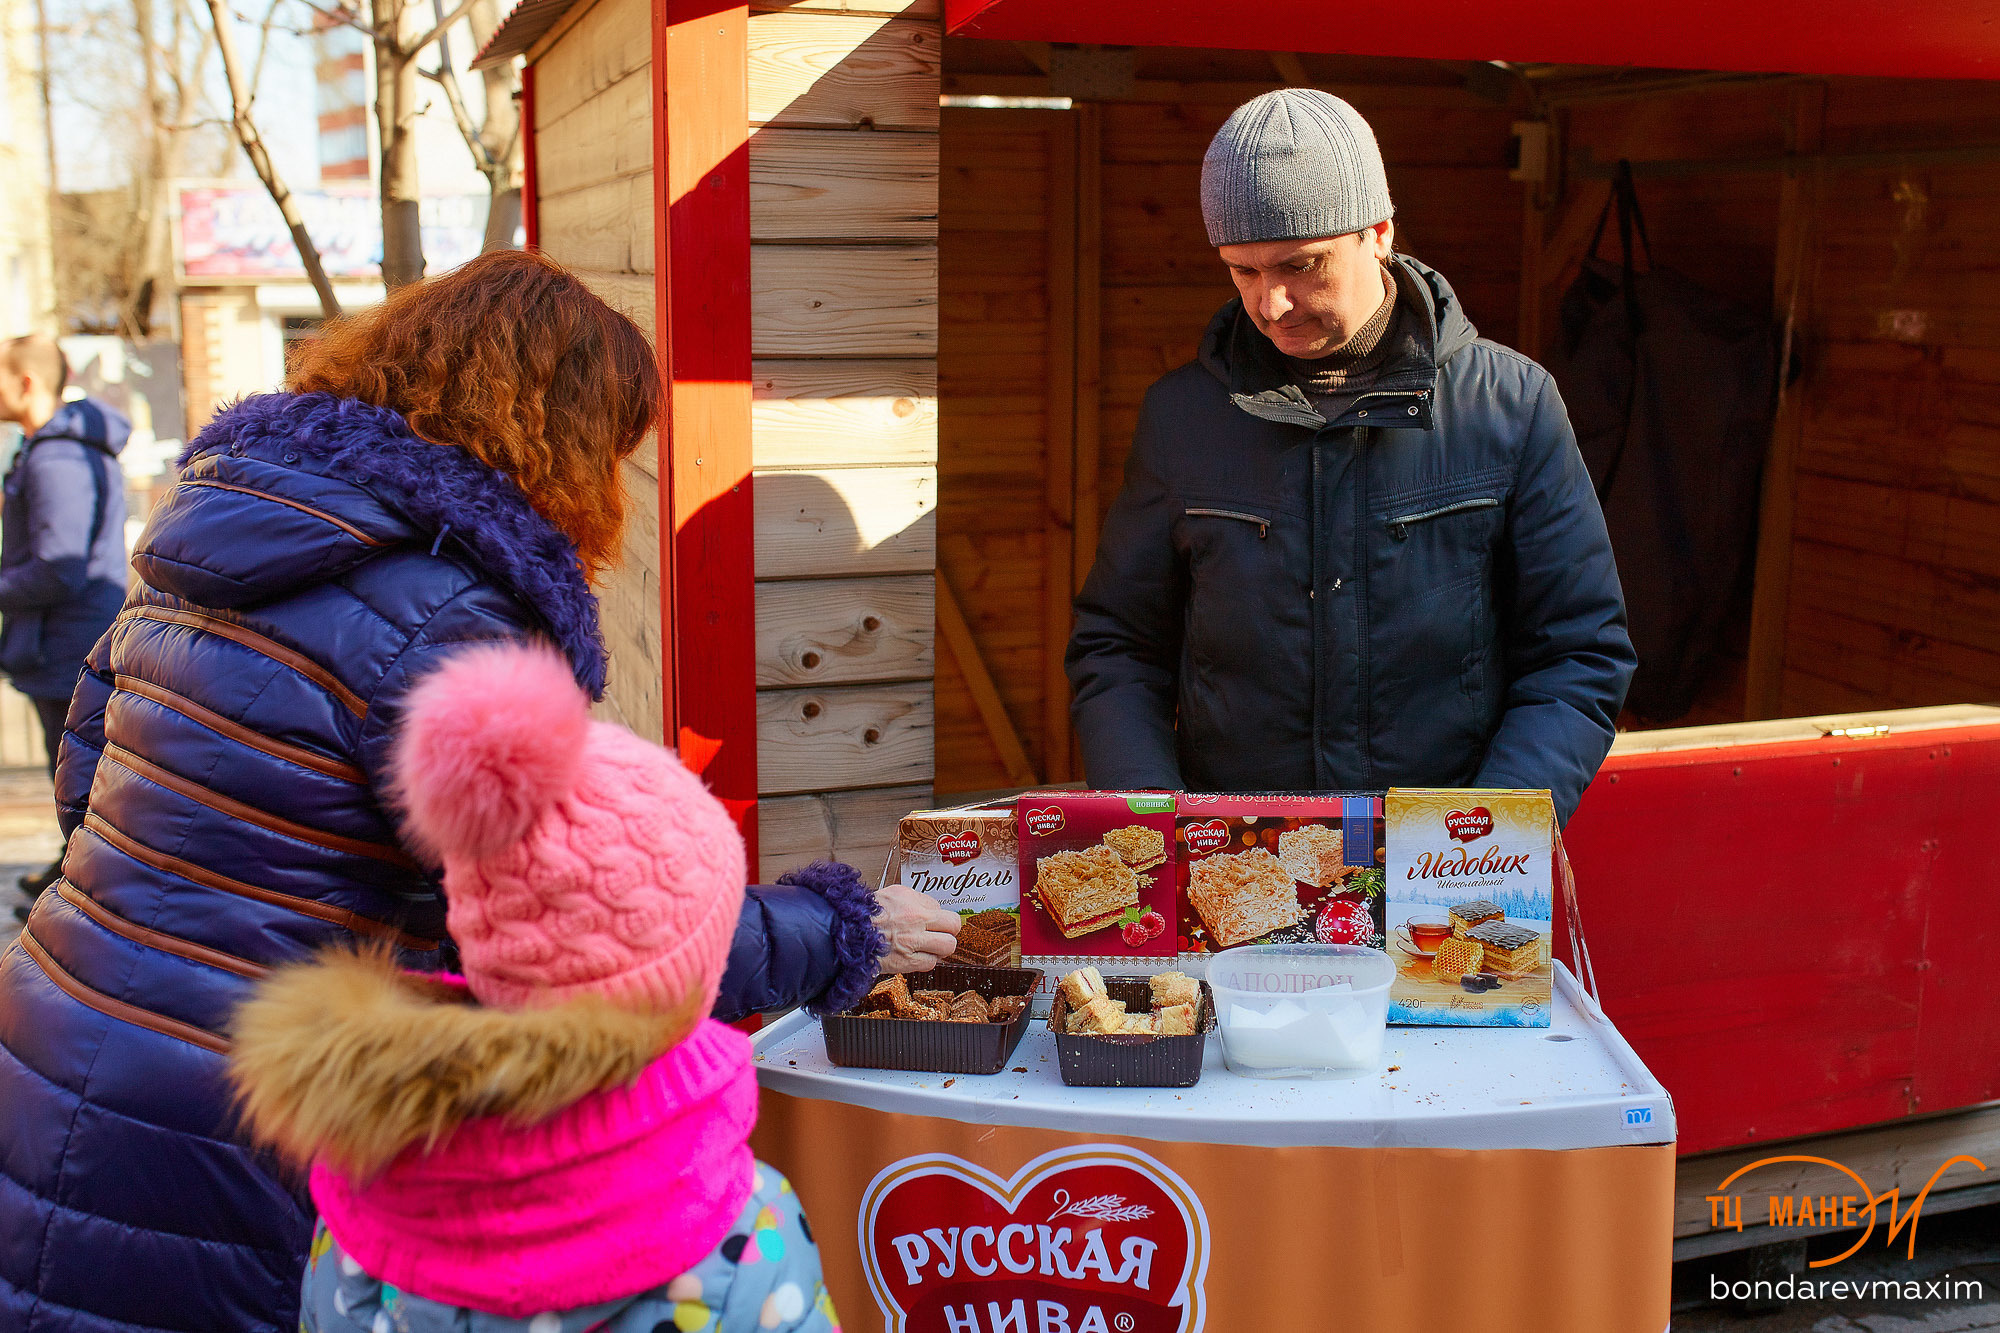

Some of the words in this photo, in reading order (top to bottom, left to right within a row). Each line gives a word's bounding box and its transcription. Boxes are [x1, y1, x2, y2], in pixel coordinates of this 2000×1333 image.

[1028, 814, 1061, 824] РУССКАЯ
[1447, 816, 1489, 828] РУССКАЯ
[1188, 829, 1225, 839] РУССКАЯ
[1457, 827, 1482, 835] НИВА
[940, 840, 978, 851] РУССКАЯ
[1197, 839, 1218, 847] НИВА
[949, 850, 971, 858] НИВА
[1407, 845, 1530, 880] Медовик
[911, 866, 1013, 896] Трюфель
[1437, 877, 1504, 889] Шоколадный
[891, 1223, 1158, 1290] РУССКАЯ
